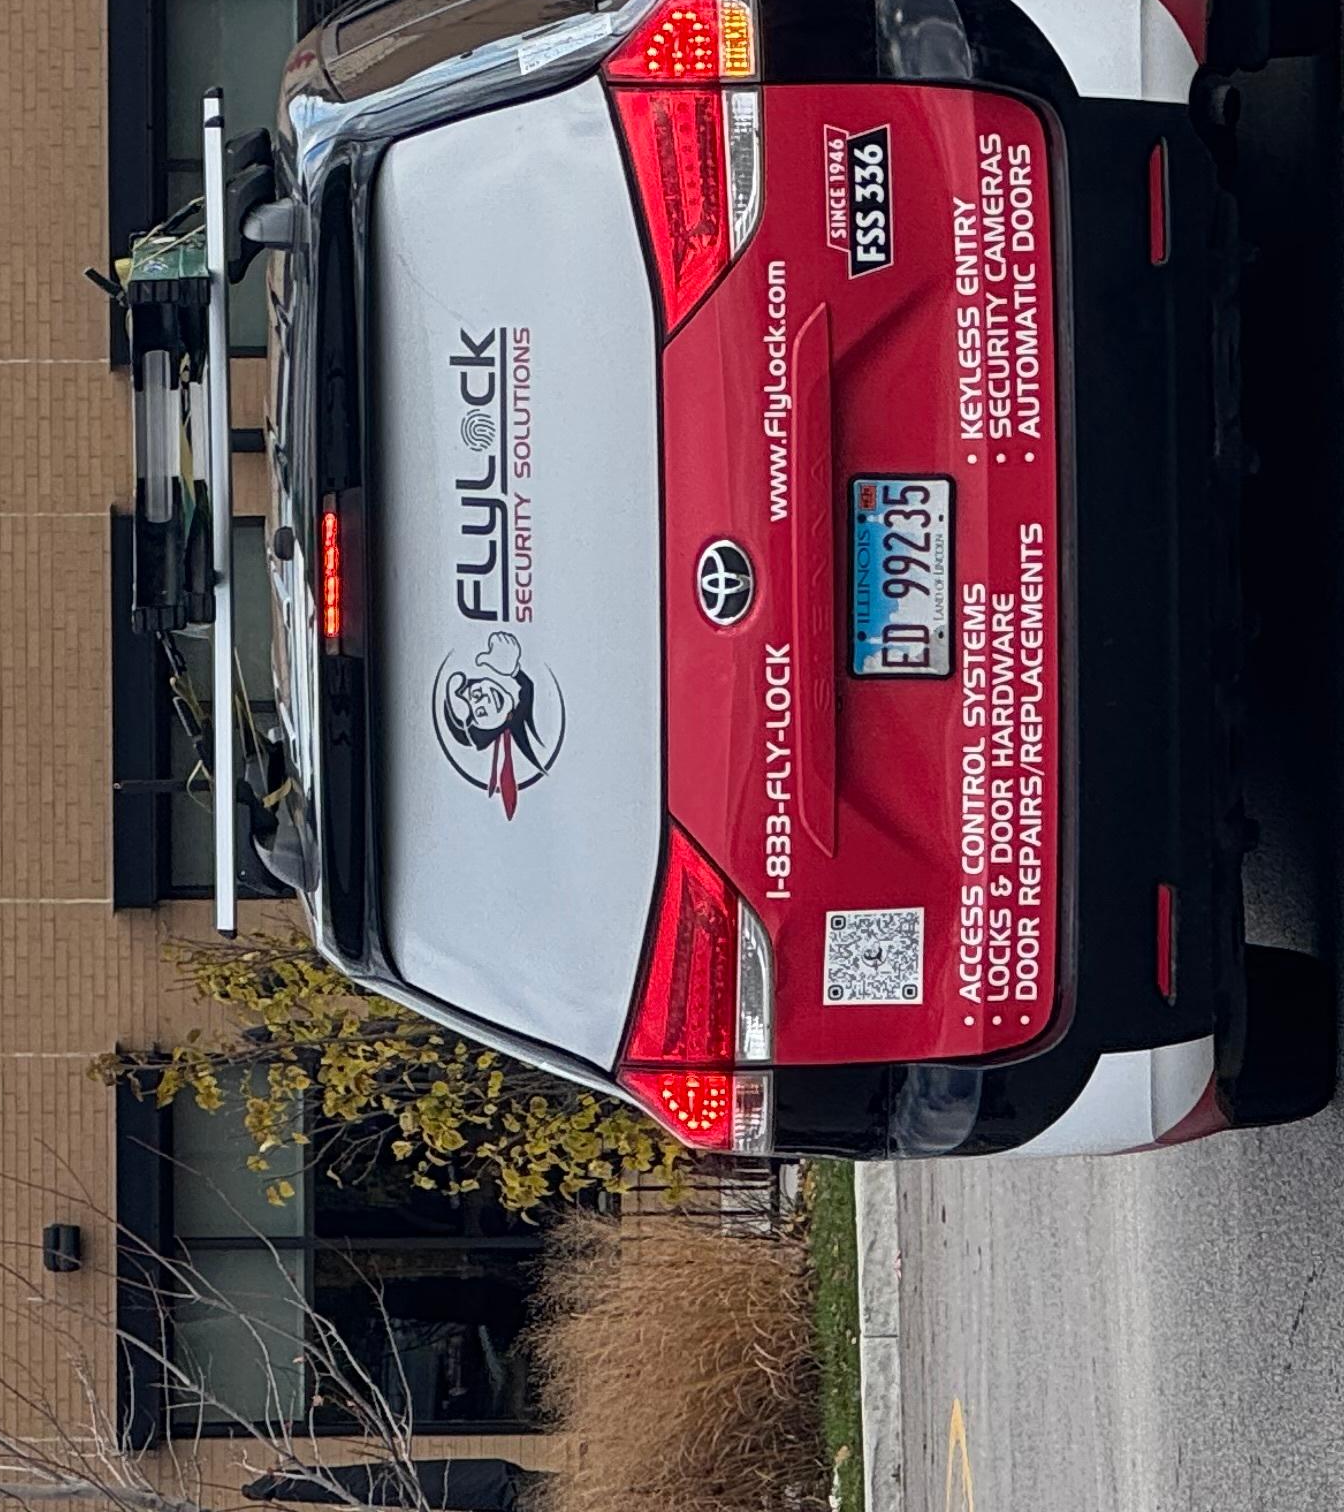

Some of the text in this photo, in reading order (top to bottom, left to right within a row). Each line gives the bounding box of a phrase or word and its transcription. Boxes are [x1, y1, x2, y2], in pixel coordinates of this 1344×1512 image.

[828, 139, 847, 238] SINCE 1946
[854, 144, 886, 261] FSS 336
[953, 196, 984, 439] KEYLESS ENTRY
[979, 134, 1012, 439] SECURITY CAMERAS
[1008, 144, 1041, 439] AUTOMATIC DOORS
[513, 327, 532, 623] SECURITY SOLUTIONS
[763, 261, 792, 521] www.FlyLock.com
[857, 530, 870, 623] ILLINOIS
[882, 485, 930, 668] ED 99235
[959, 583, 986, 1003] ACCESS CONTROL SYSTEMS
[988, 593, 1014, 1002] LOCKS & DOOR HARDWARE
[1015, 523, 1045, 1000] DOOR REPAIRS/REPLACEMENTS
